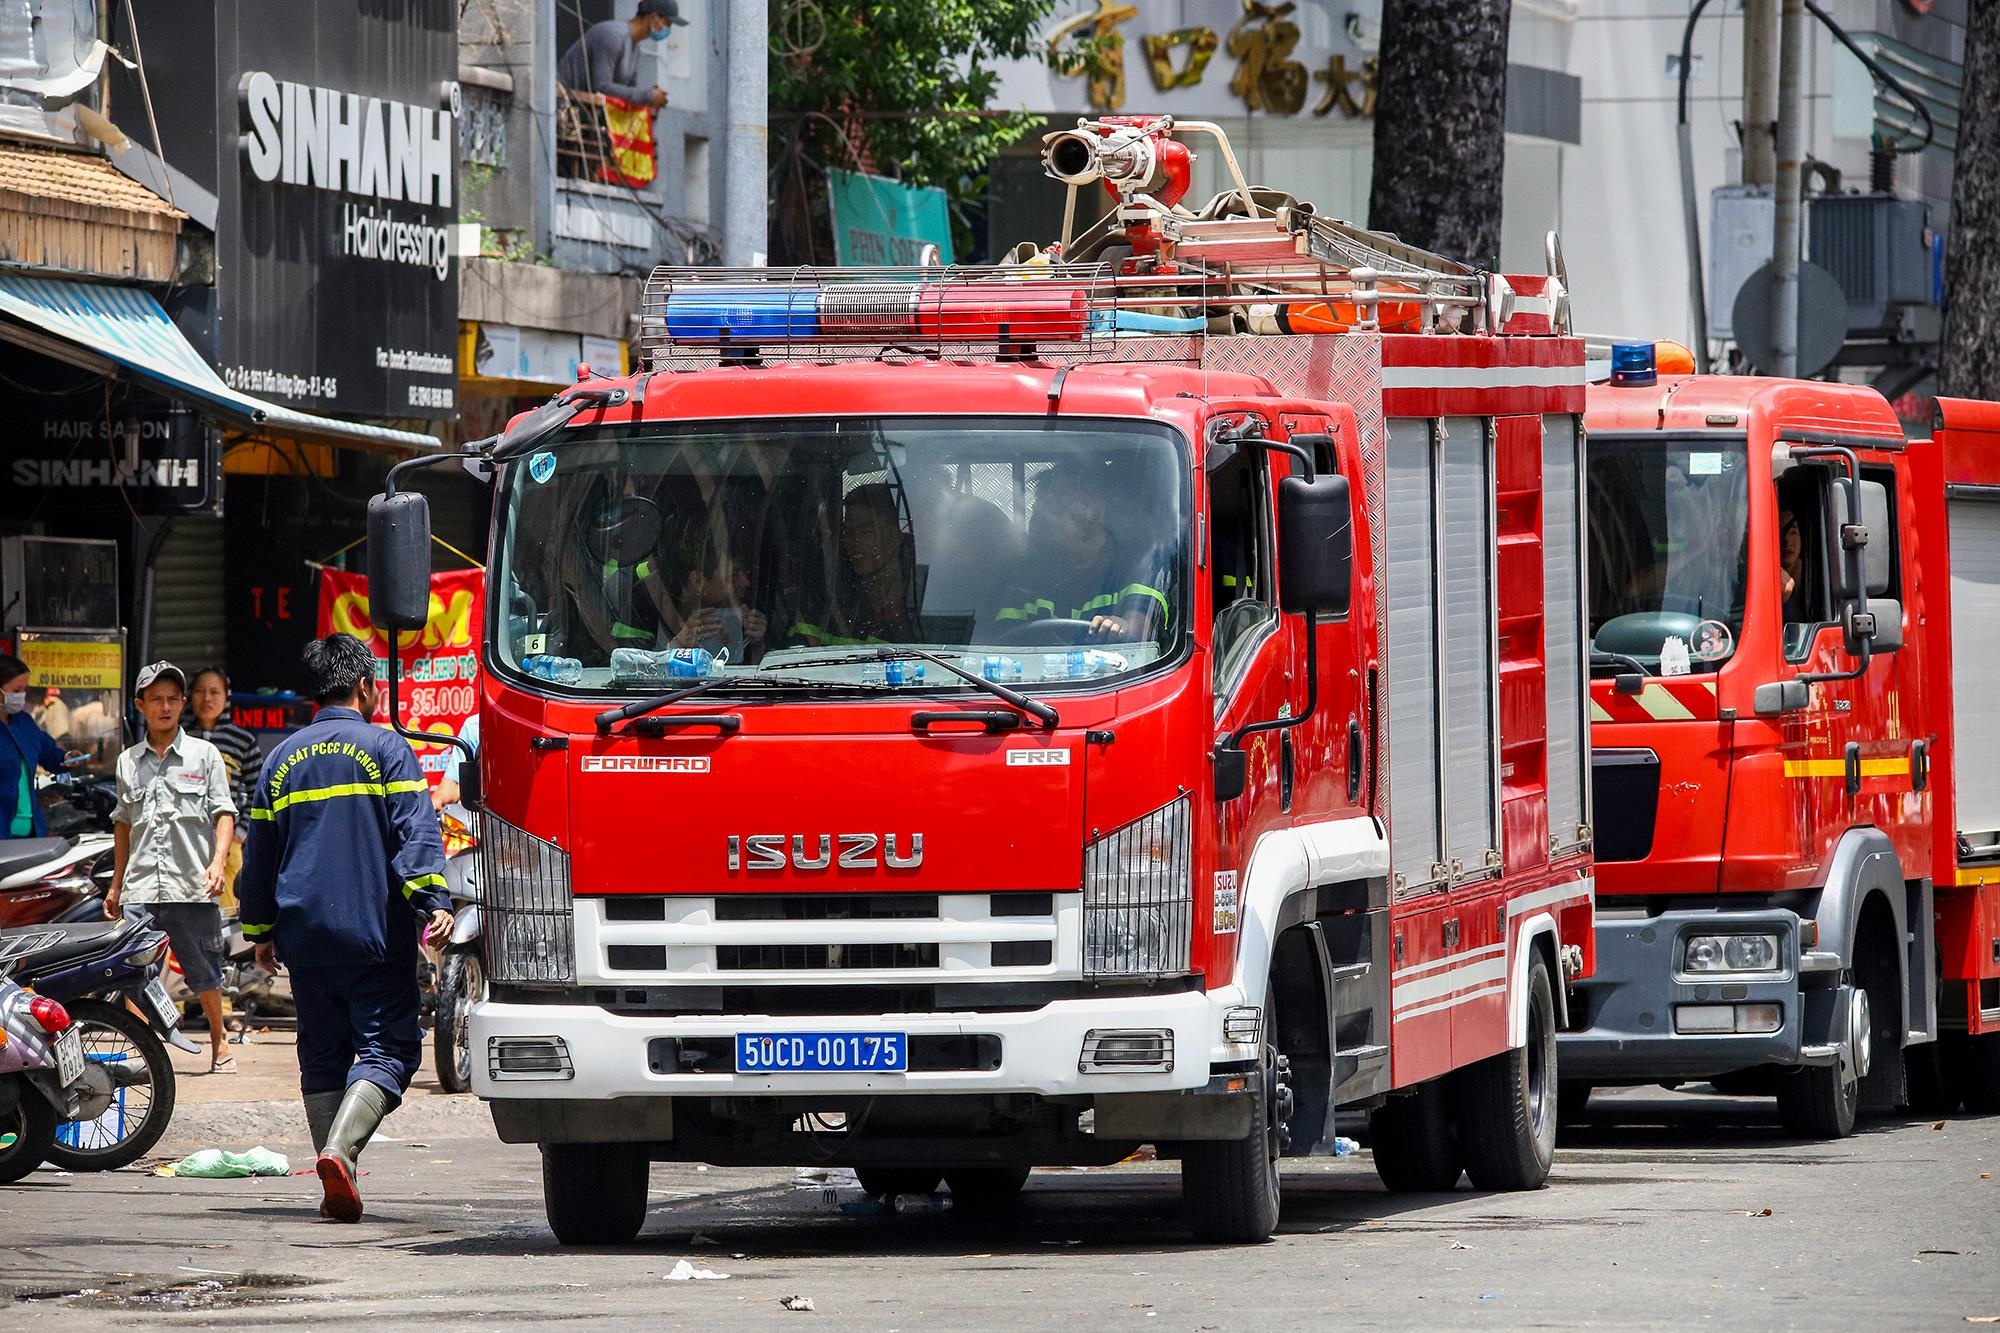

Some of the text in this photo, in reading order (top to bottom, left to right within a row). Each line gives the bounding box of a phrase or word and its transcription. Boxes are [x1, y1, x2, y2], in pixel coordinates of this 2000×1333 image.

[240, 71, 451, 208] SINHANH
[344, 203, 448, 281] Hairdressing
[44, 420, 170, 439] HAIR SAON
[12, 458, 199, 487] SINHANH
[331, 589, 475, 648] CM
[532, 639, 539, 649] 6
[432, 657, 457, 680] KHO
[410, 686, 475, 717] 35.000
[311, 742, 341, 757] PCCC
[355, 750, 382, 781] CNCH
[584, 758, 708, 770] FORWARD
[1010, 751, 1064, 763] FRR
[727, 833, 923, 869] ISUZU
[1214, 874, 1237, 891] ISUZU
[745, 1037, 897, 1067] 50CD-001.75
